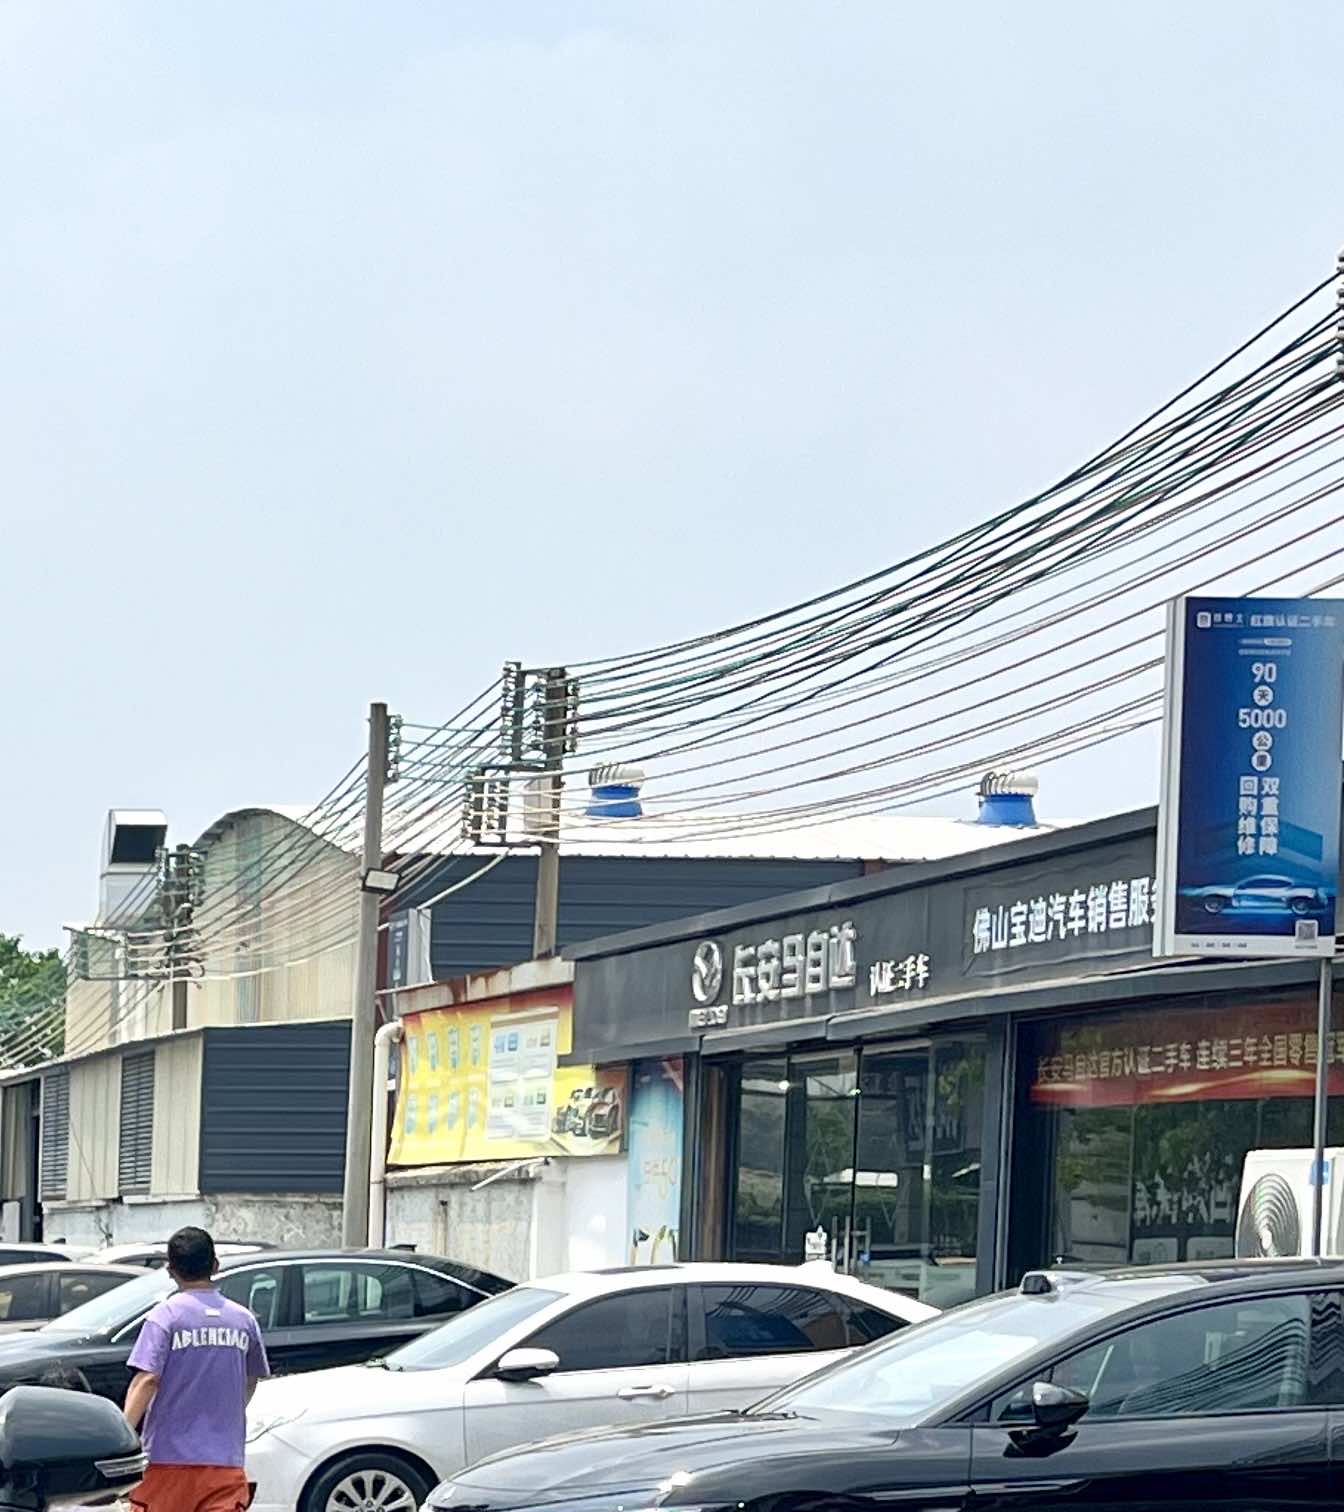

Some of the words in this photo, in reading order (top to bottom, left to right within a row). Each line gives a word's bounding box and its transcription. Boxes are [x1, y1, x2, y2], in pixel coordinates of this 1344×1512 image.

[1251, 662, 1277, 683] 90
[1238, 708, 1287, 728] 5000
[973, 876, 1157, 954] 佛山宝迪汽车销售服
[733, 920, 857, 1006] 长安马自达
